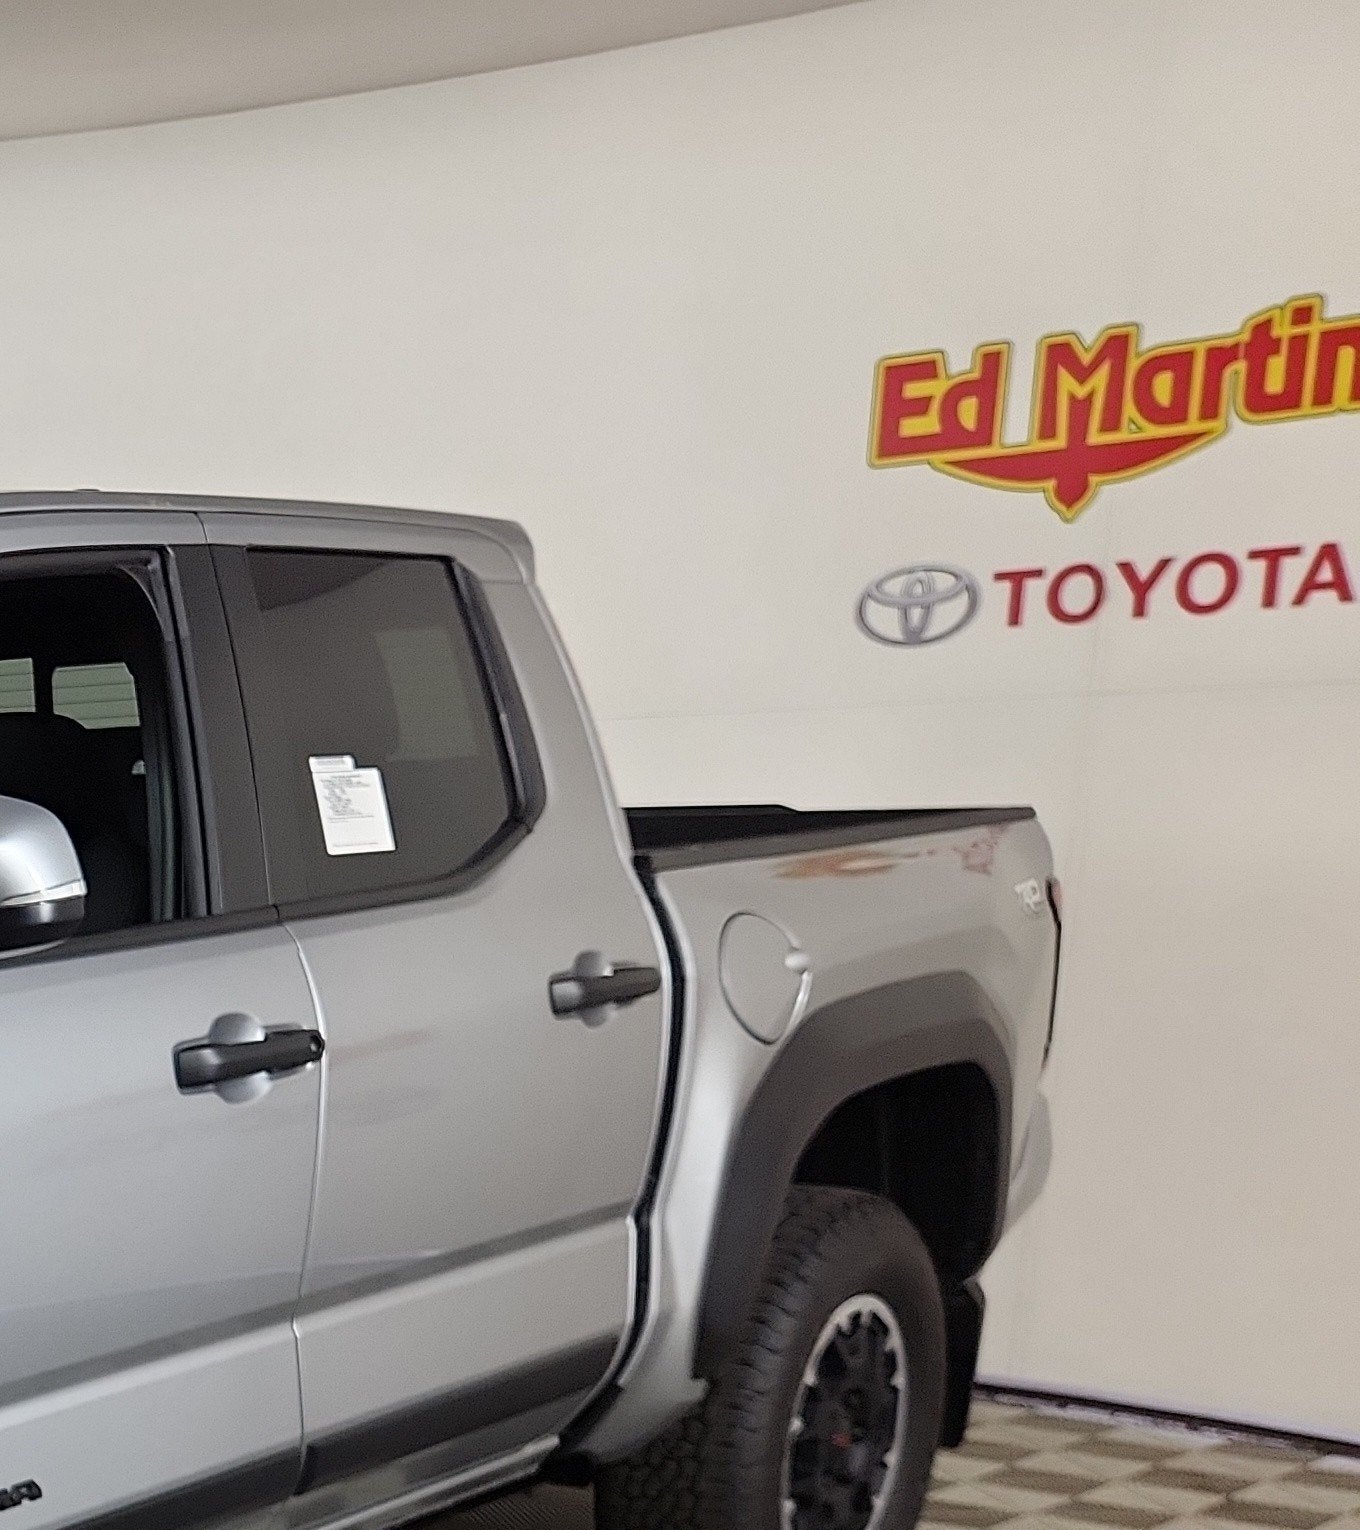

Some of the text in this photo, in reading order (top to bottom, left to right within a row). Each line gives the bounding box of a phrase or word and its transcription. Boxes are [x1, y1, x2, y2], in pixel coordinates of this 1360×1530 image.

[875, 300, 1360, 463] Ed Martin
[993, 542, 1354, 628] TOYOTA
